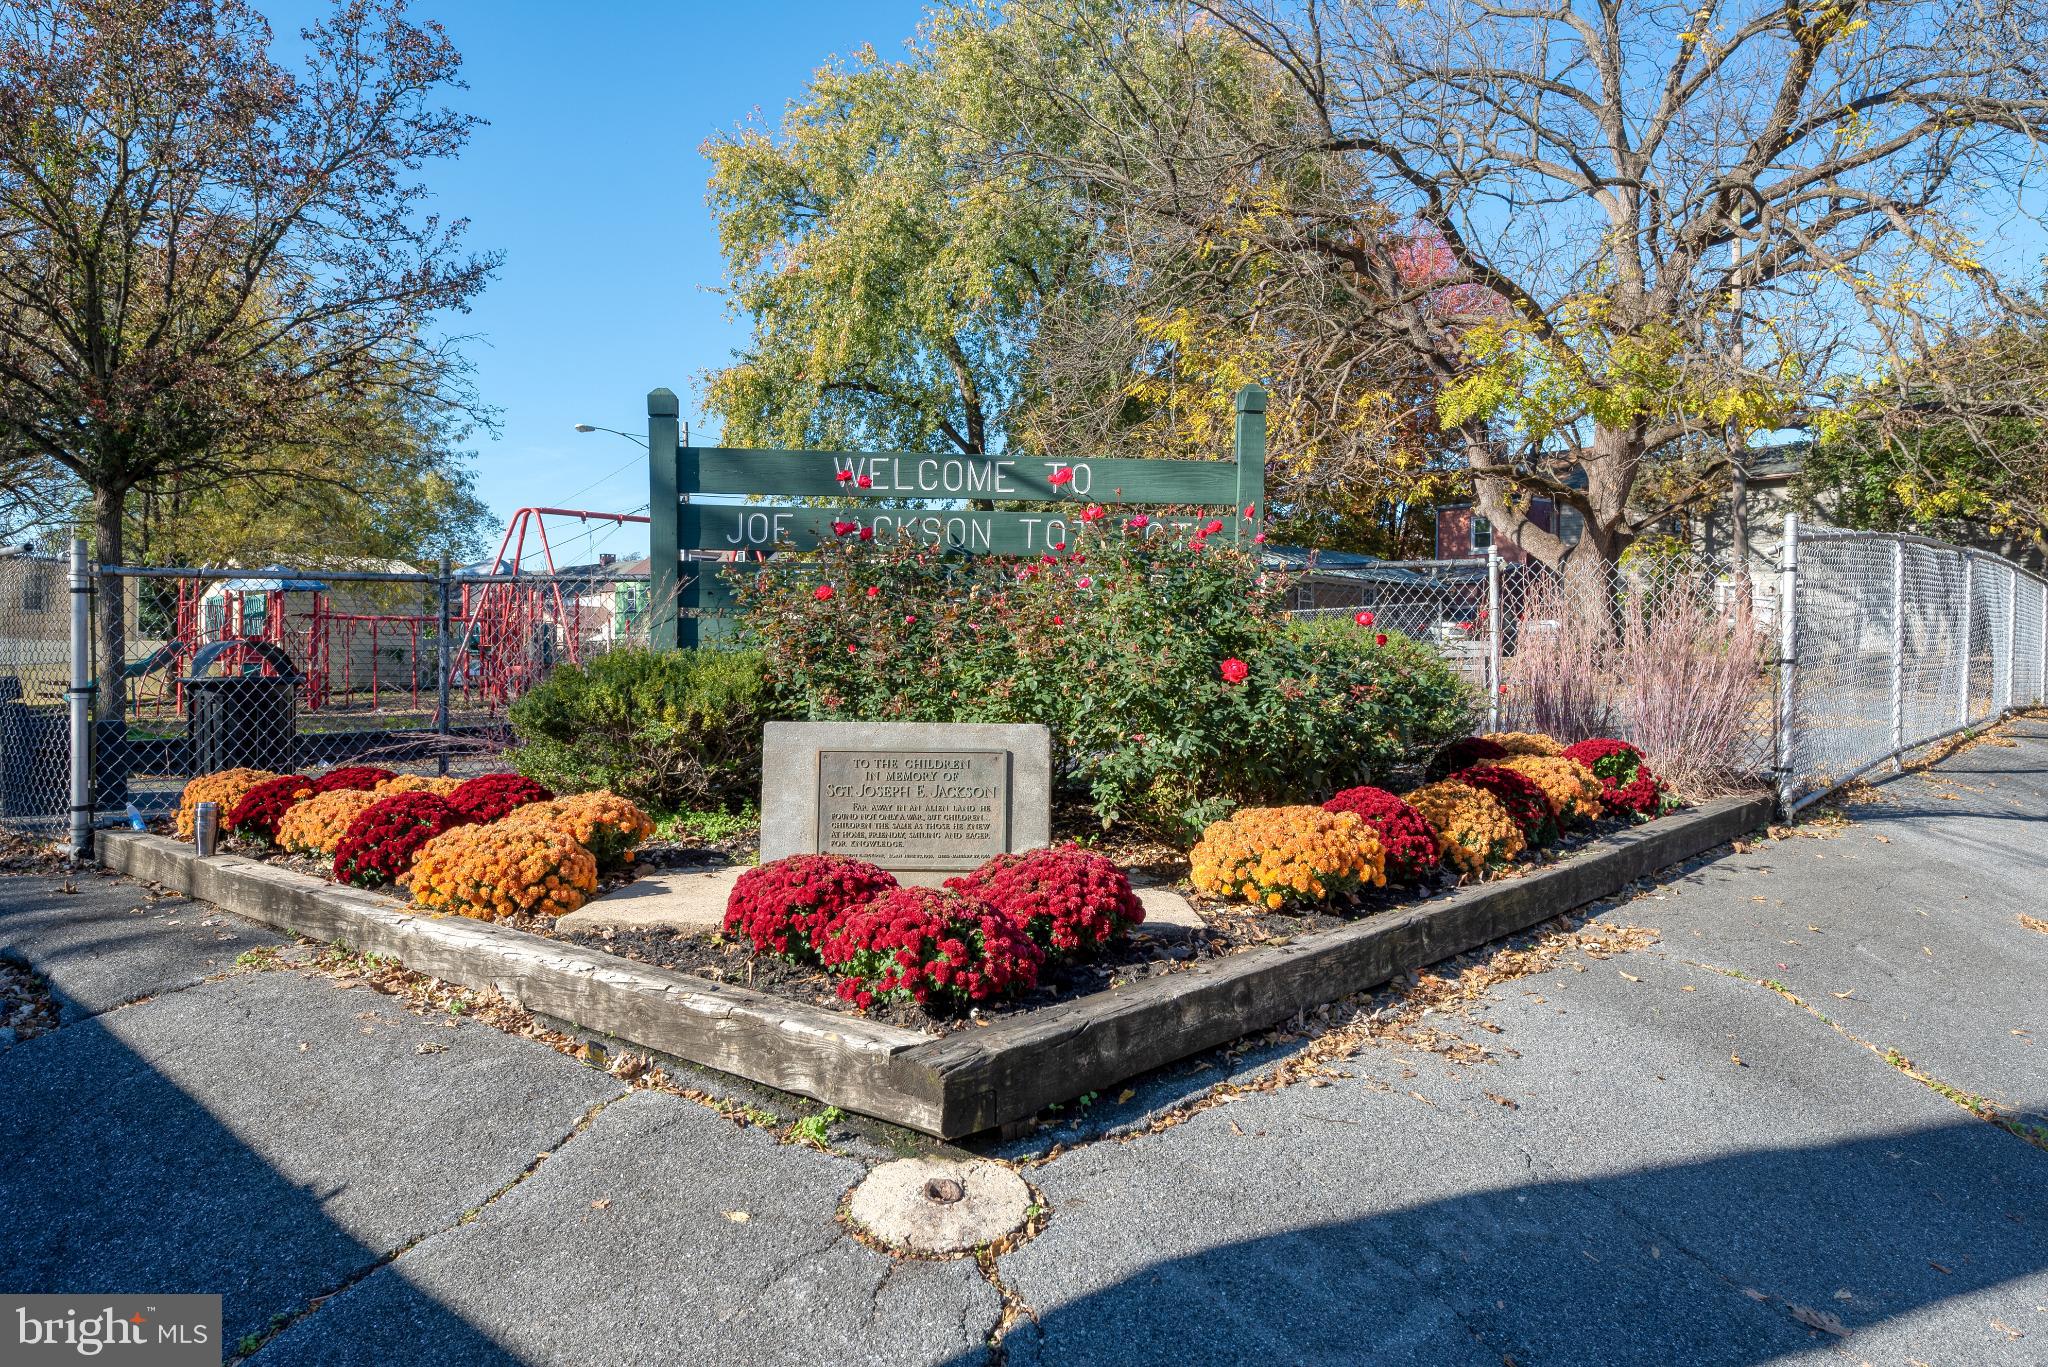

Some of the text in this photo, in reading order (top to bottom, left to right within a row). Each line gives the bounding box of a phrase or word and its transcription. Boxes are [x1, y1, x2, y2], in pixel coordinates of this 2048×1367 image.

[834, 457, 1091, 495] WELCOME TO
[726, 512, 794, 544] JOE
[853, 759, 971, 769] TO THE CHILDREN
[865, 772, 960, 781] IN MEMORY OF
[856, 785, 911, 798] JOSEPH
[917, 785, 928, 798] E.
[930, 785, 997, 799] JACKSON
[853, 803, 868, 811] FAR
[831, 813, 858, 821] FOUND
[860, 813, 878, 821] NOT
[892, 822, 912, 830] SAME
